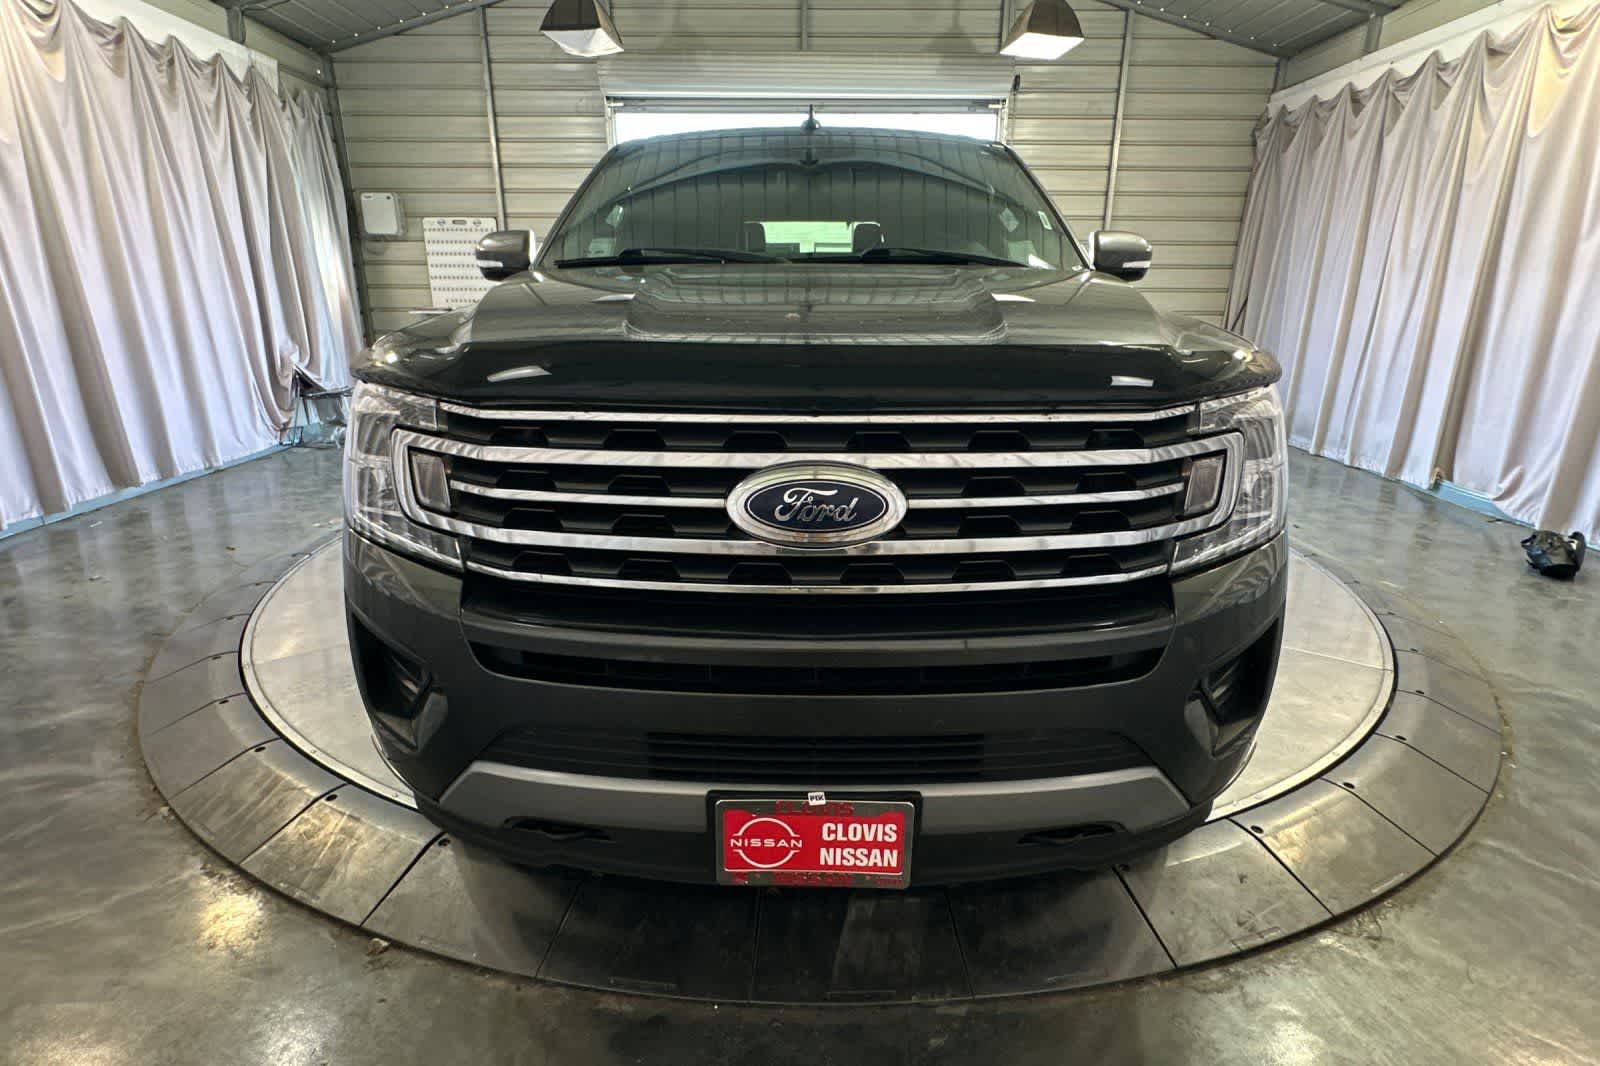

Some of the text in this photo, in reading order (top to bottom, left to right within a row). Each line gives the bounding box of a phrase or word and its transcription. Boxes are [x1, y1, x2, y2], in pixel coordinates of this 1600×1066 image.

[774, 487, 859, 522] Ford
[822, 822, 898, 842] CLOVIS
[730, 838, 803, 849] NISSAN
[820, 848, 898, 867] NISSAN
